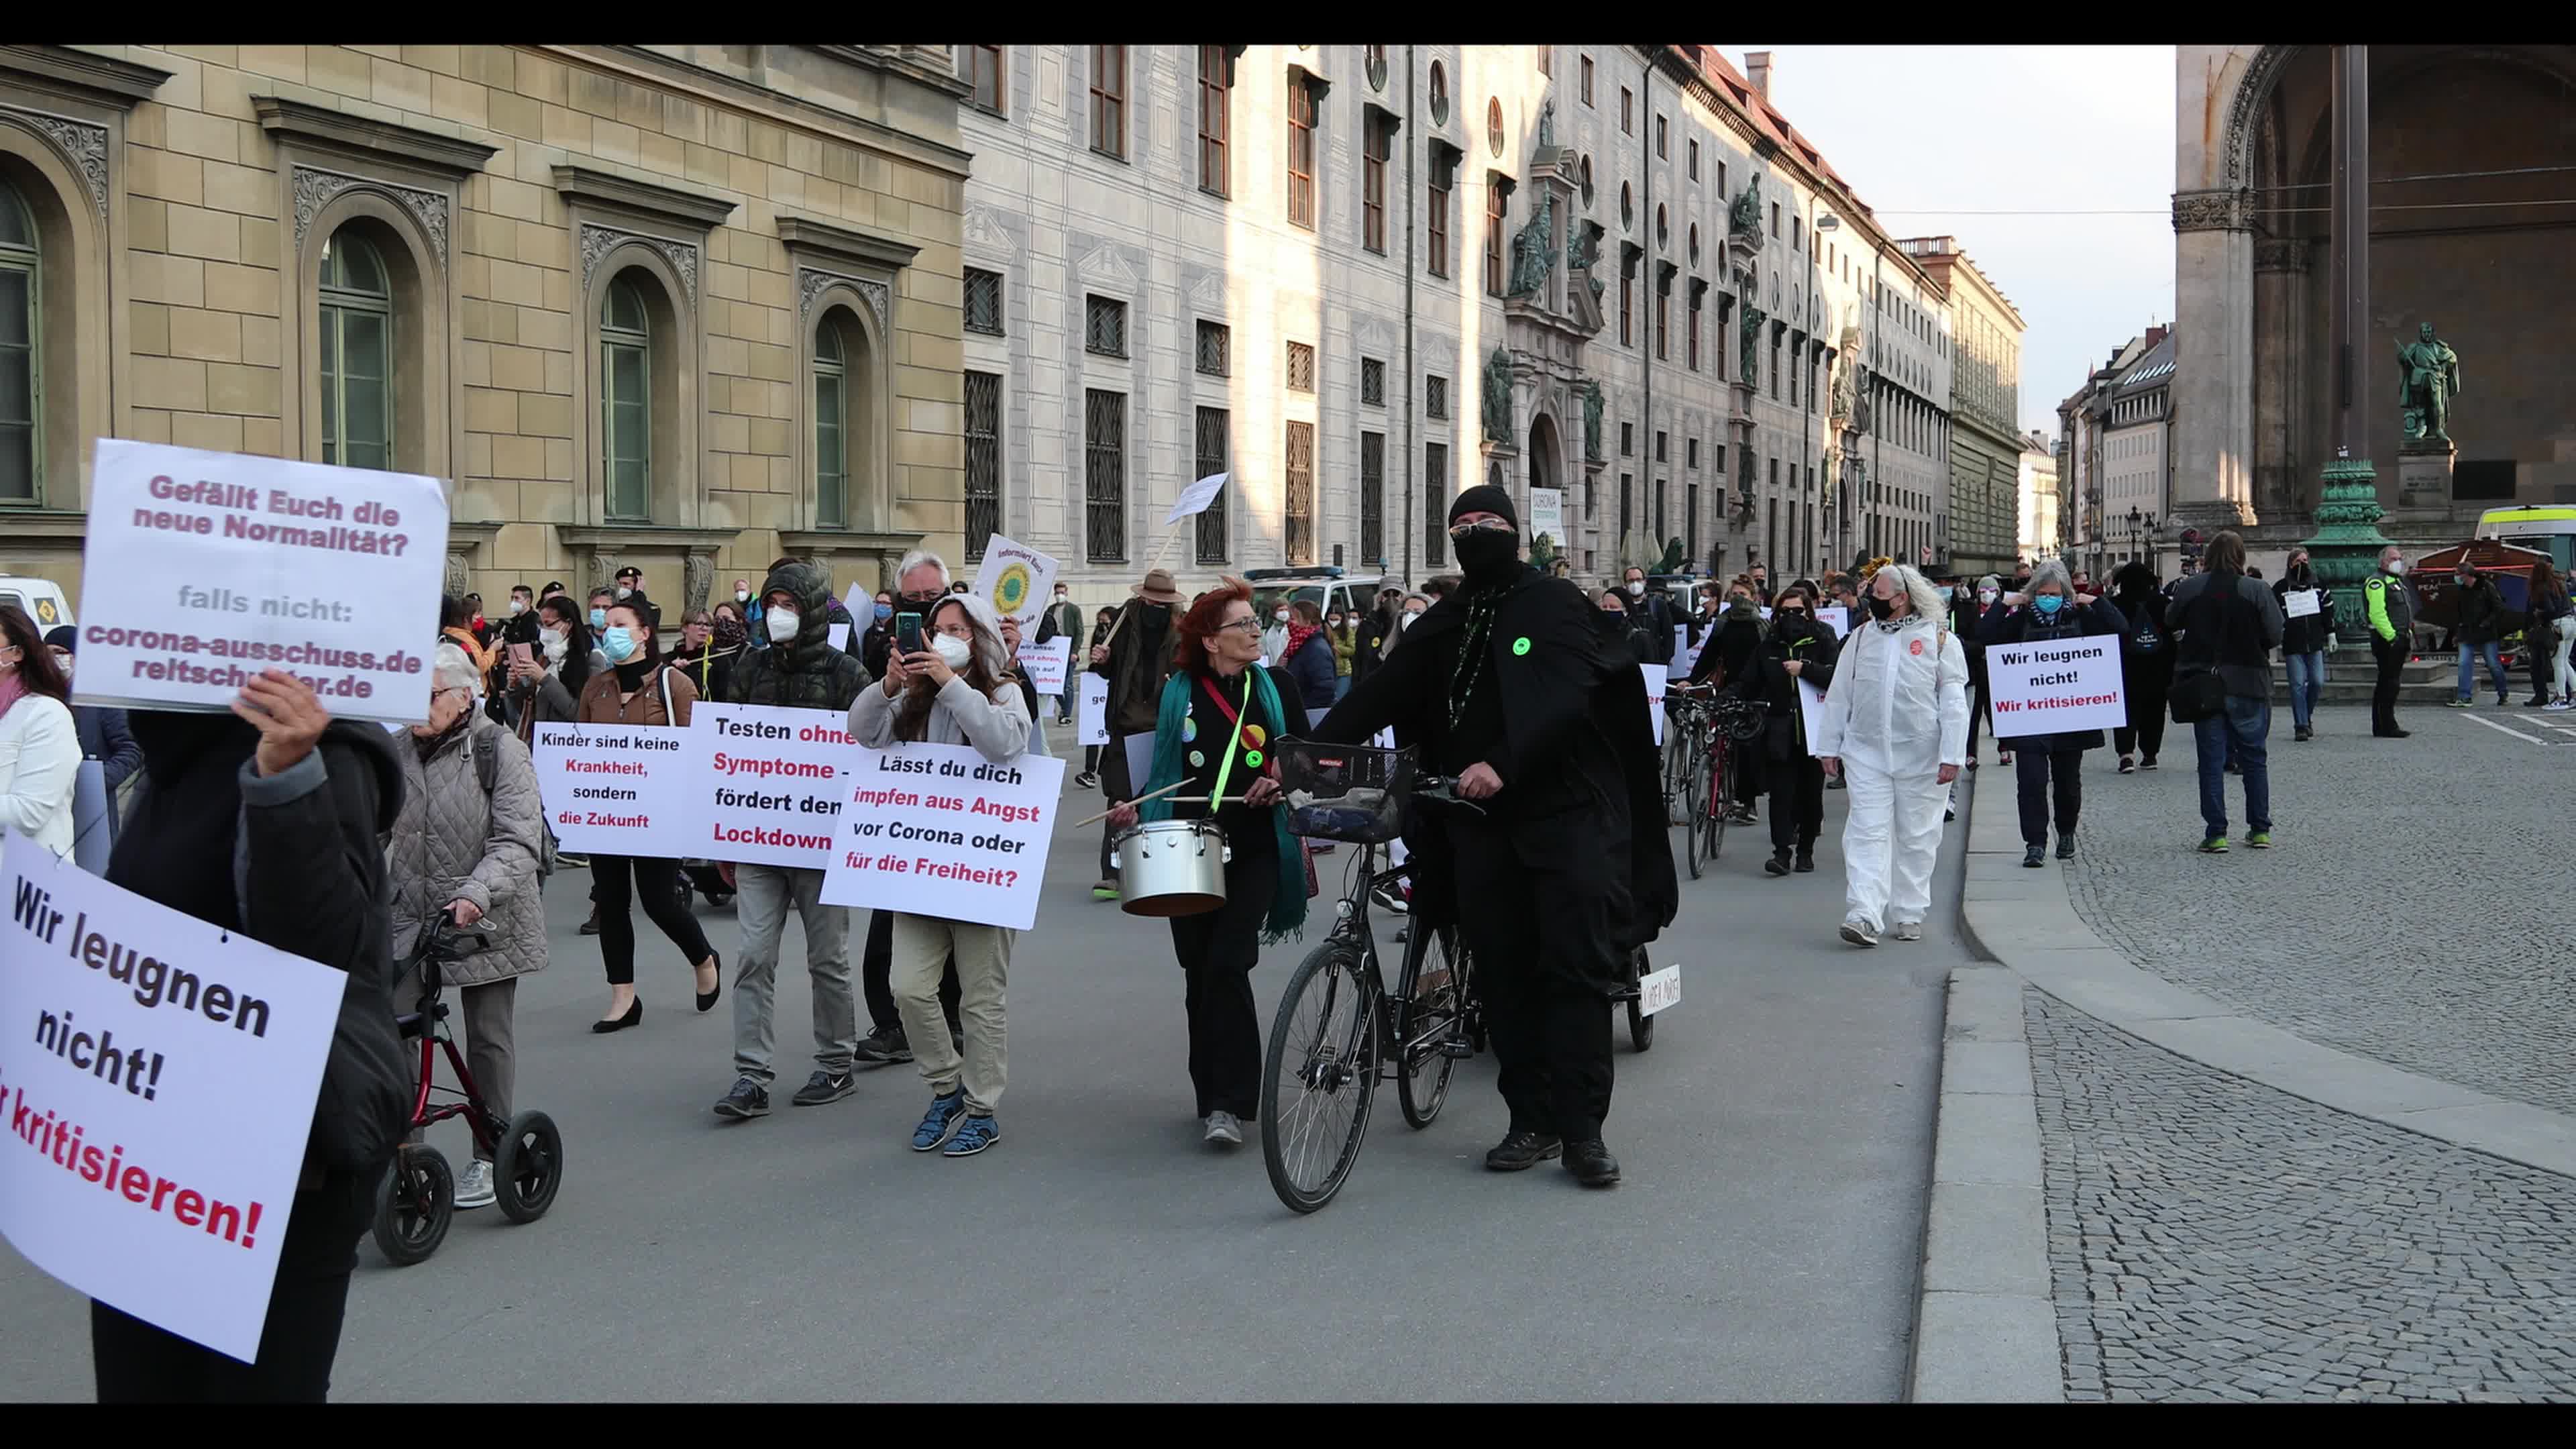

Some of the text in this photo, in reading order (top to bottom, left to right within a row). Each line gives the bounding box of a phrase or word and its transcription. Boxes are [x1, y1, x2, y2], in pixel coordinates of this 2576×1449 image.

[150, 475, 258, 511] Gefällt
[268, 489, 343, 521] Euch
[133, 507, 409, 557] neue Normalität?
[178, 584, 353, 623] falls nicht:
[85, 625, 423, 674] corona-ausschuss.de
[2002, 647, 2102, 665] Wir leugnen
[132, 658, 374, 698] reitscher.de
[2030, 671, 2078, 686] nicht!
[1996, 692, 2117, 712] Wir kritisieren!
[541, 733, 680, 751] Kinder sind keine
[716, 717, 857, 745] Testen ohne
[566, 759, 648, 778] Krankheit,
[714, 752, 835, 779] Symptome
[879, 755, 1022, 785] Lässt du dich
[573, 786, 637, 800] sondern
[715, 788, 842, 815] fördert den
[853, 786, 1040, 822] impfen aus Angst
[558, 811, 649, 828] die Zukunft
[714, 822, 833, 850] Lockdown
[853, 821, 1025, 854] vor Corona oder
[846, 852, 1018, 888] für die Freiheit?
[14, 875, 270, 1038] Wir leugnen
[36, 1009, 165, 1102] nicht!
[11, 1087, 264, 1250] kritisieren!
